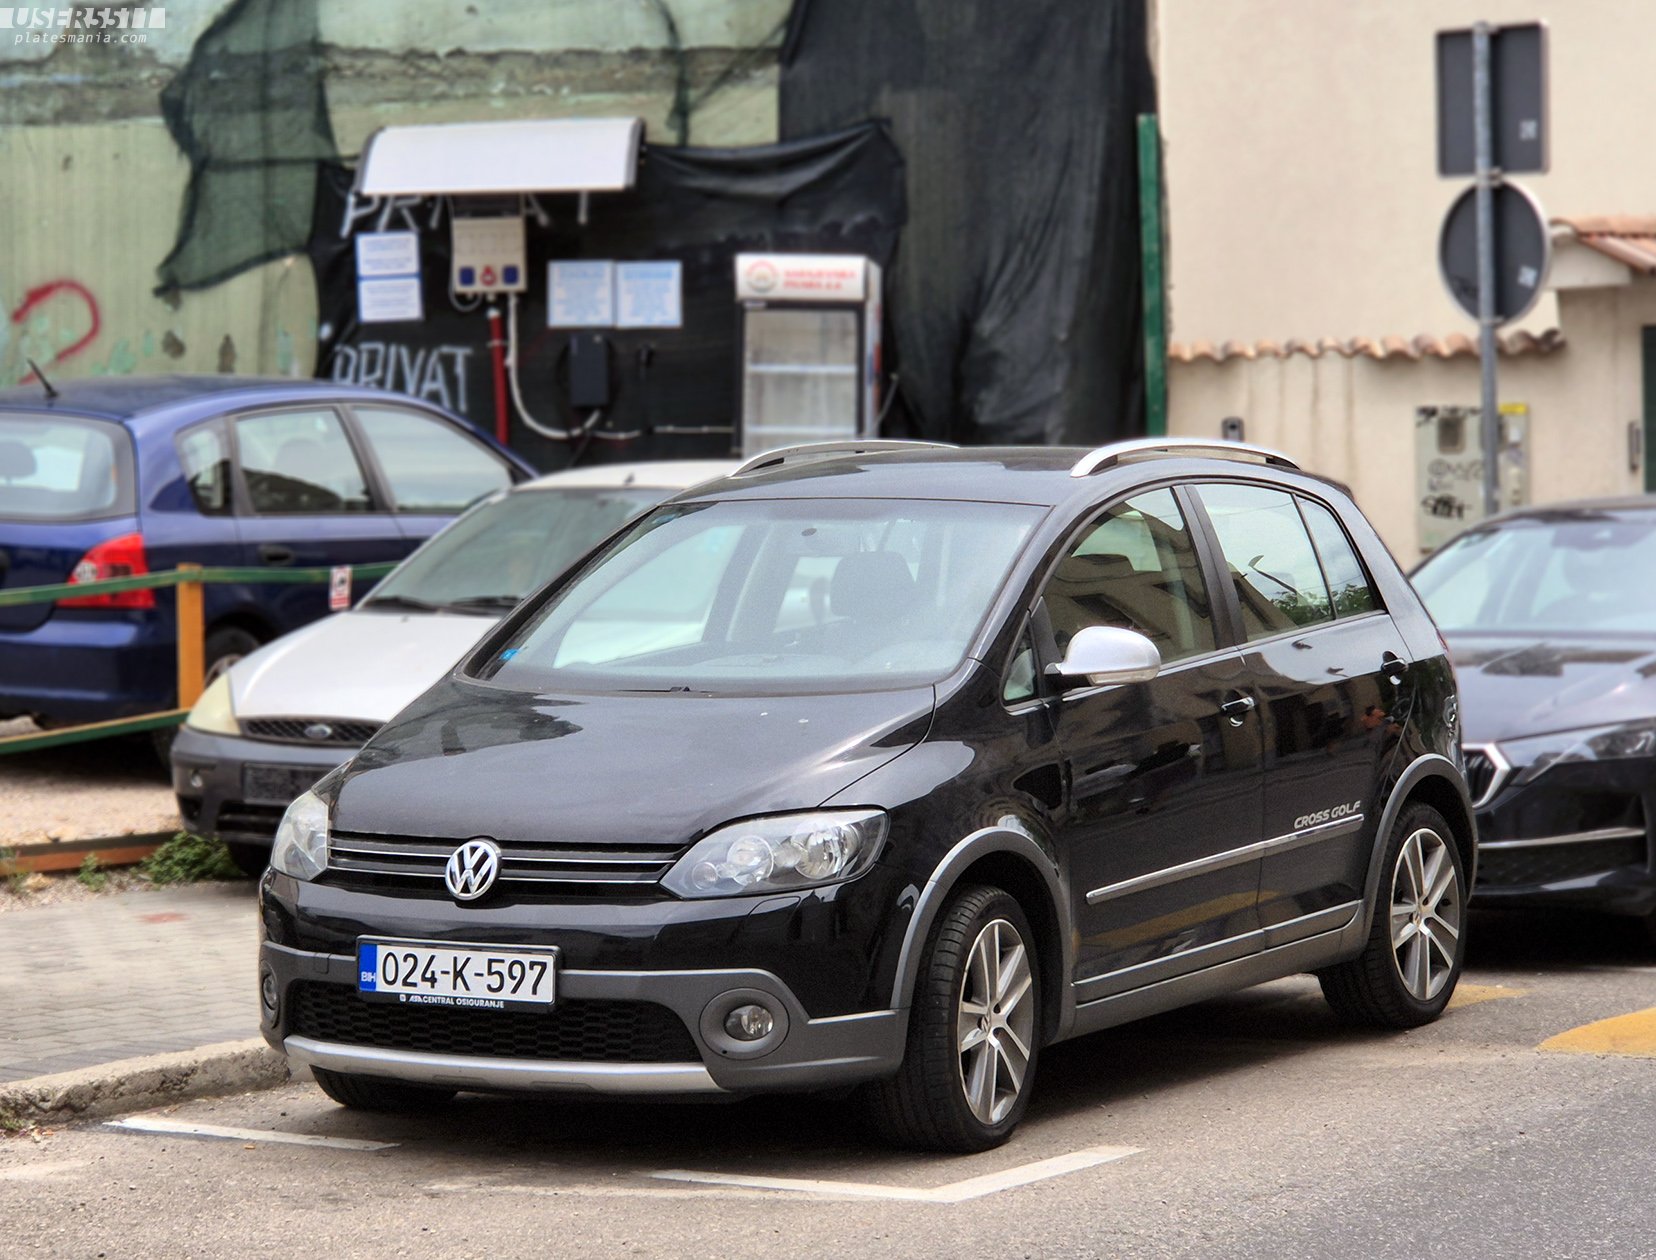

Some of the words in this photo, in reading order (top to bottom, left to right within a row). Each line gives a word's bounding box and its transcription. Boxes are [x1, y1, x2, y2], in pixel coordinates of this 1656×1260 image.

[1294, 808, 1330, 829] CROSS
[1331, 800, 1361, 818] GOLF
[361, 971, 376, 982] BIH
[382, 952, 547, 995] 024-K-597
[456, 998, 505, 1009] OSIGURANJE
